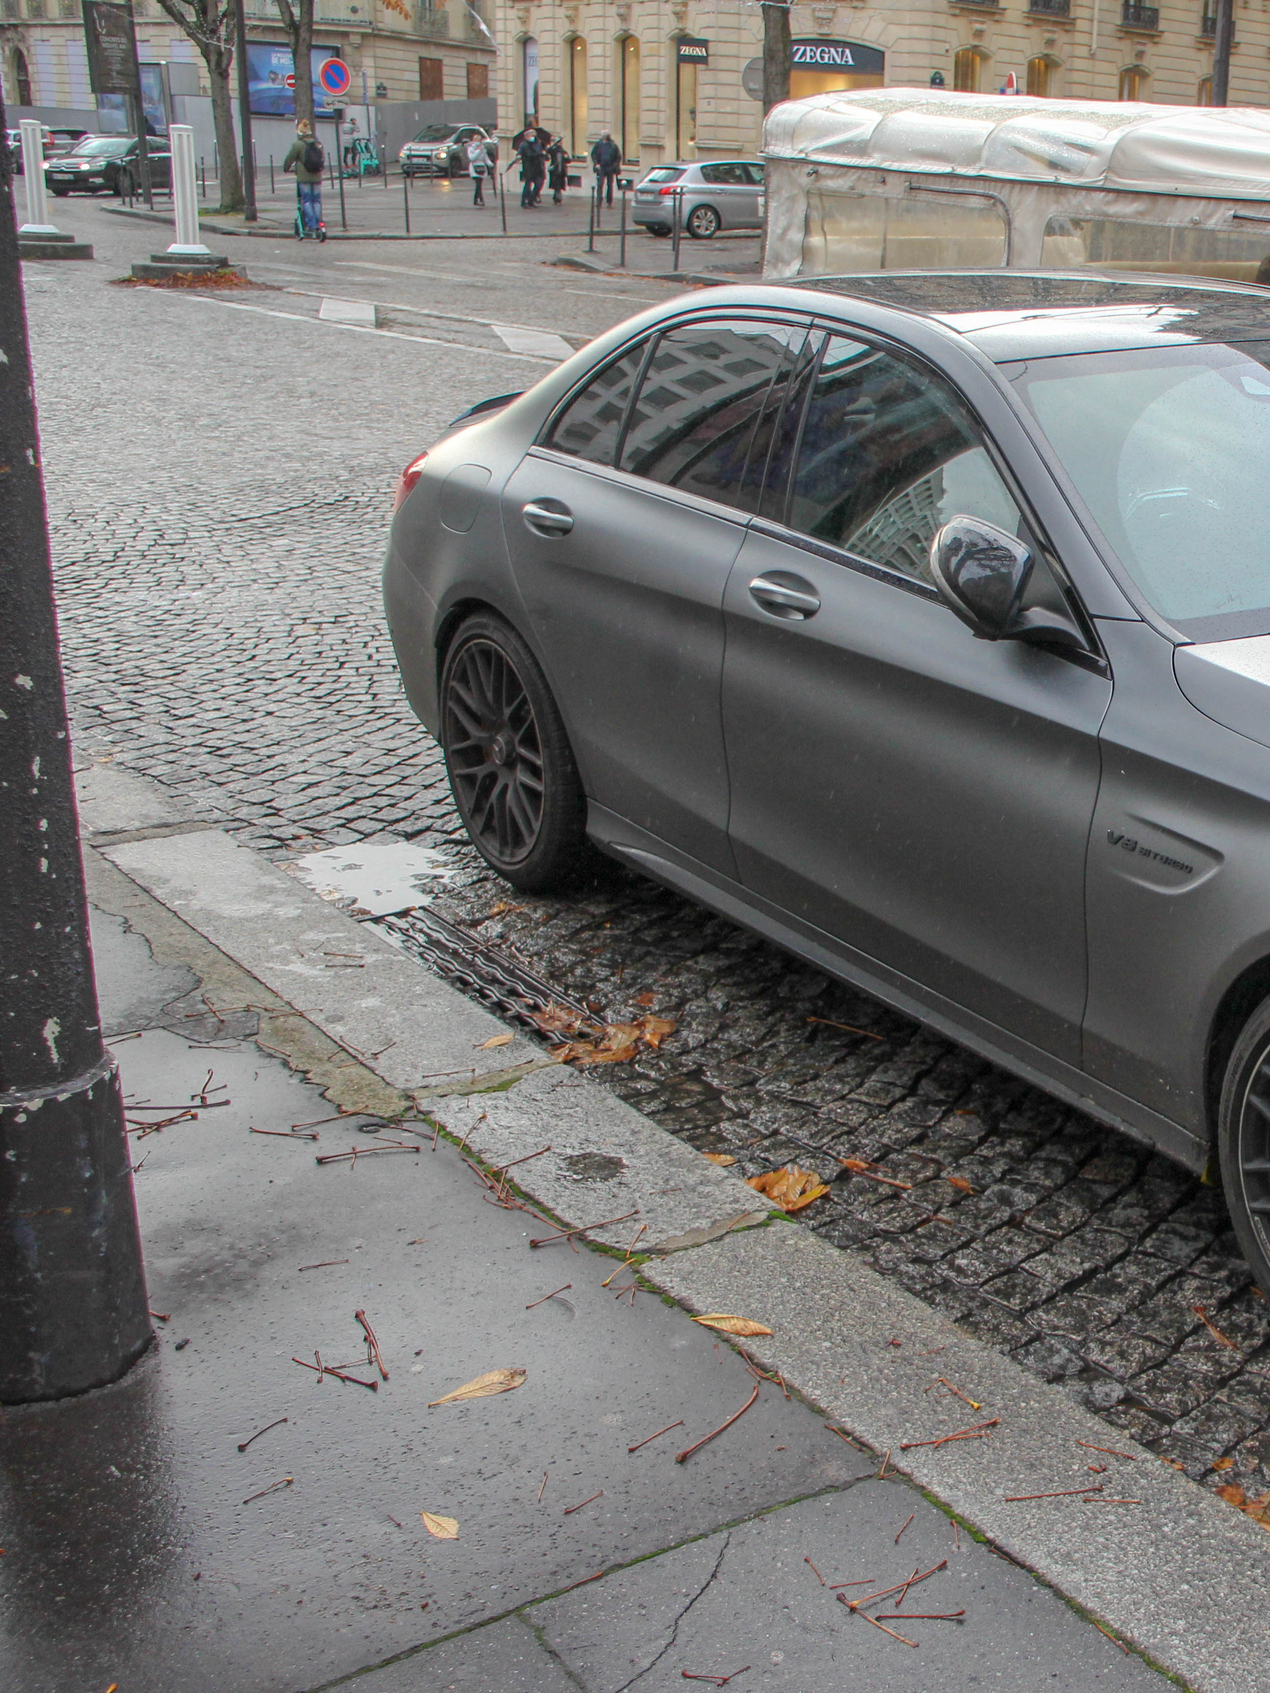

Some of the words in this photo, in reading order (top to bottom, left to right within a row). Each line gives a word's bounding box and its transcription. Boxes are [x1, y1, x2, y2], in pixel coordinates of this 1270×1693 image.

[679, 45, 707, 57] ZEGNA
[792, 45, 856, 66] ZEGNA
[1106, 829, 1138, 852] V8
